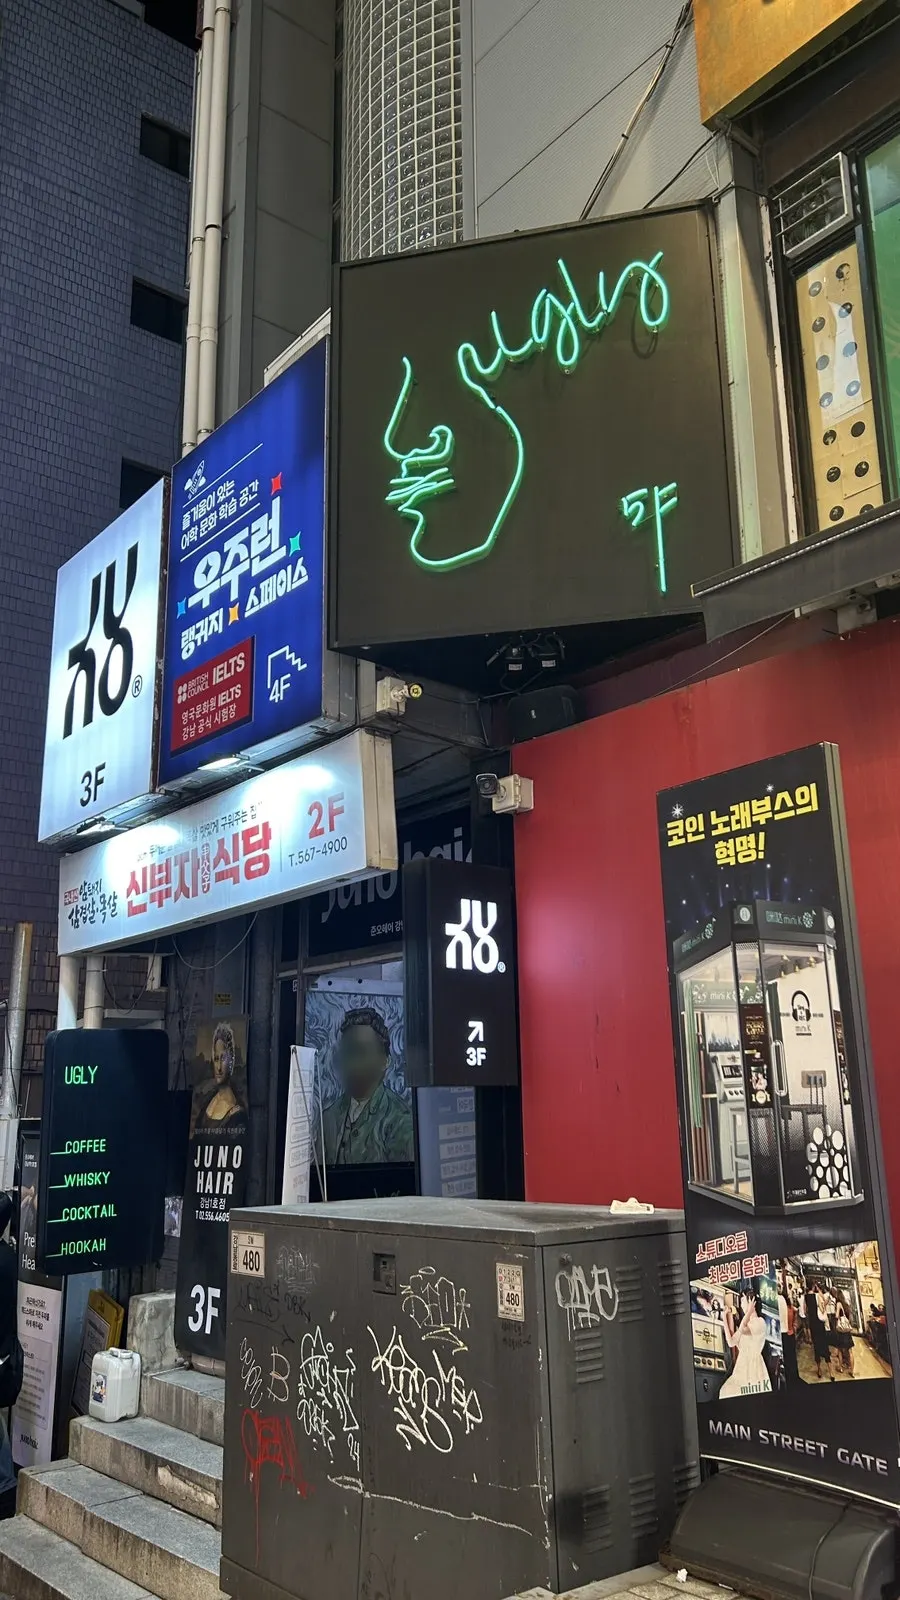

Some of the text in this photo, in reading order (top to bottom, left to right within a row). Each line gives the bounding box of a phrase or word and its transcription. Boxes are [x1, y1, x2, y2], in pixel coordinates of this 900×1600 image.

[180, 478, 259, 550] 어학 문화 학습 공간
[182, 479, 235, 531] 즐거움이 있는
[187, 495, 287, 609] 우주런
[244, 556, 309, 618] 스페이스
[181, 607, 224, 660] 랭귀지
[187, 651, 245, 690] BRITISH IELTS
[187, 680, 210, 699] COUNCIL
[269, 673, 291, 703] 4F
[181, 683, 242, 726] 영국문화원 IELTS
[182, 703, 237, 741] 강남 공식 시험장
[79, 762, 106, 808] 3F
[307, 791, 345, 840] 2F
[666, 782, 818, 848] 코인 노래부스의
[288, 836, 348, 868] T.567-4900
[714, 831, 766, 866] 혁명!
[466, 1047, 487, 1066] 3F
[64, 1065, 98, 1085] UGLY
[65, 1138, 106, 1154] COFFEE
[194, 1145, 243, 1169] JUNO
[64, 1171, 111, 1187] WHISKY
[196, 1170, 234, 1195] HAIR
[62, 1204, 117, 1222] COCKTAIL
[200, 1197, 226, 1210] 강남1호점
[23, 1231, 37, 1248] Pre
[60, 1238, 107, 1256] HOOKAH
[695, 1230, 748, 1264] 스튜디오급
[242, 1249, 260, 1272] 480
[707, 1254, 769, 1285] 최상의 음향!
[188, 1284, 220, 1335] 3F
[505, 1292, 520, 1307] 480
[740, 1379, 770, 1395] mini K
[709, 1419, 889, 1476] MAIN STREET GATE
